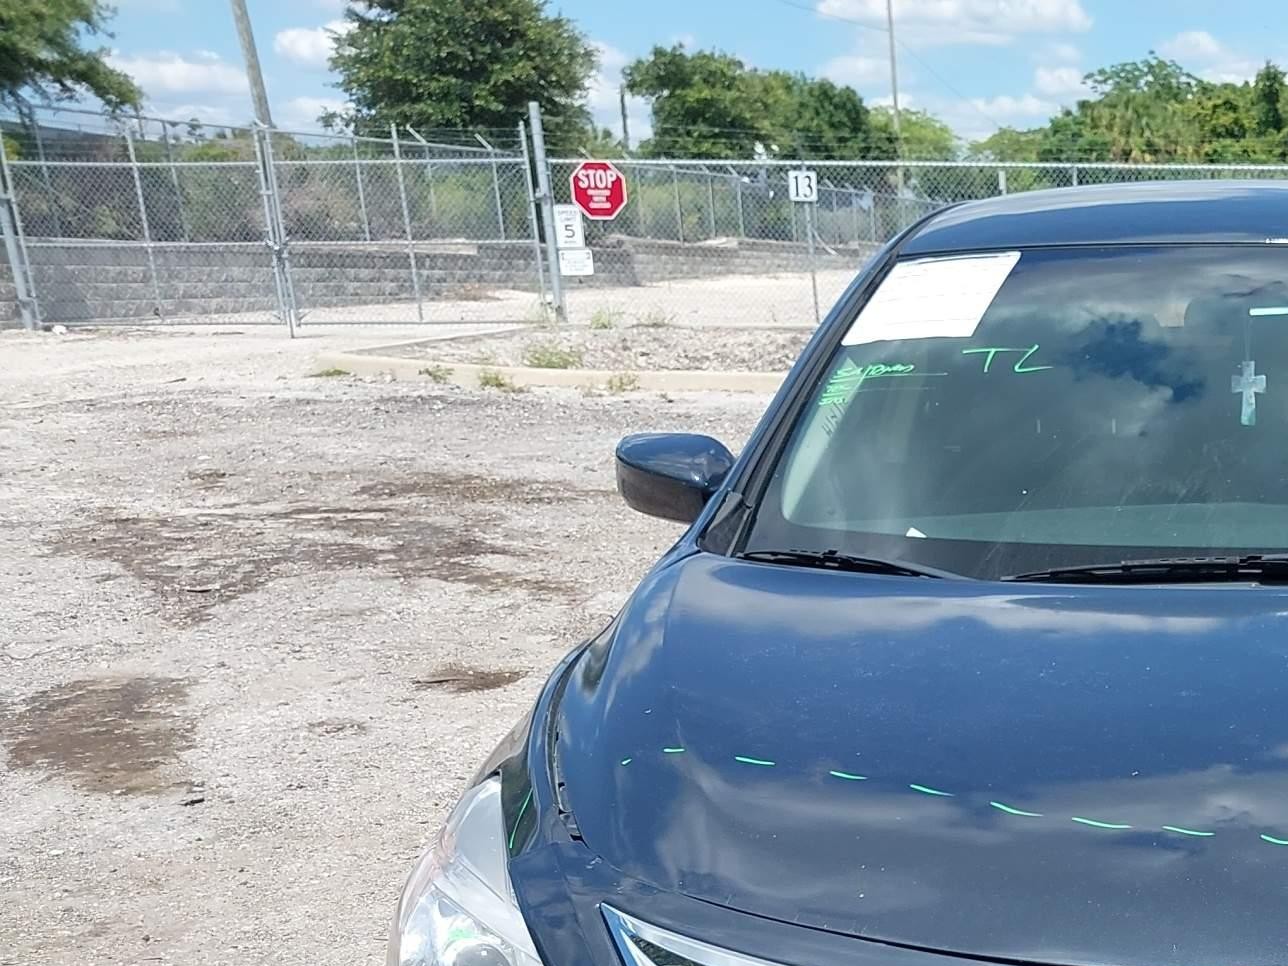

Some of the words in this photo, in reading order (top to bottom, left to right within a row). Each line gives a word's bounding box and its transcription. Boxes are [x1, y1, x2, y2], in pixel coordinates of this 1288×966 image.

[577, 169, 617, 189] STOP
[793, 175, 813, 198] 13
[564, 224, 576, 239] 5
